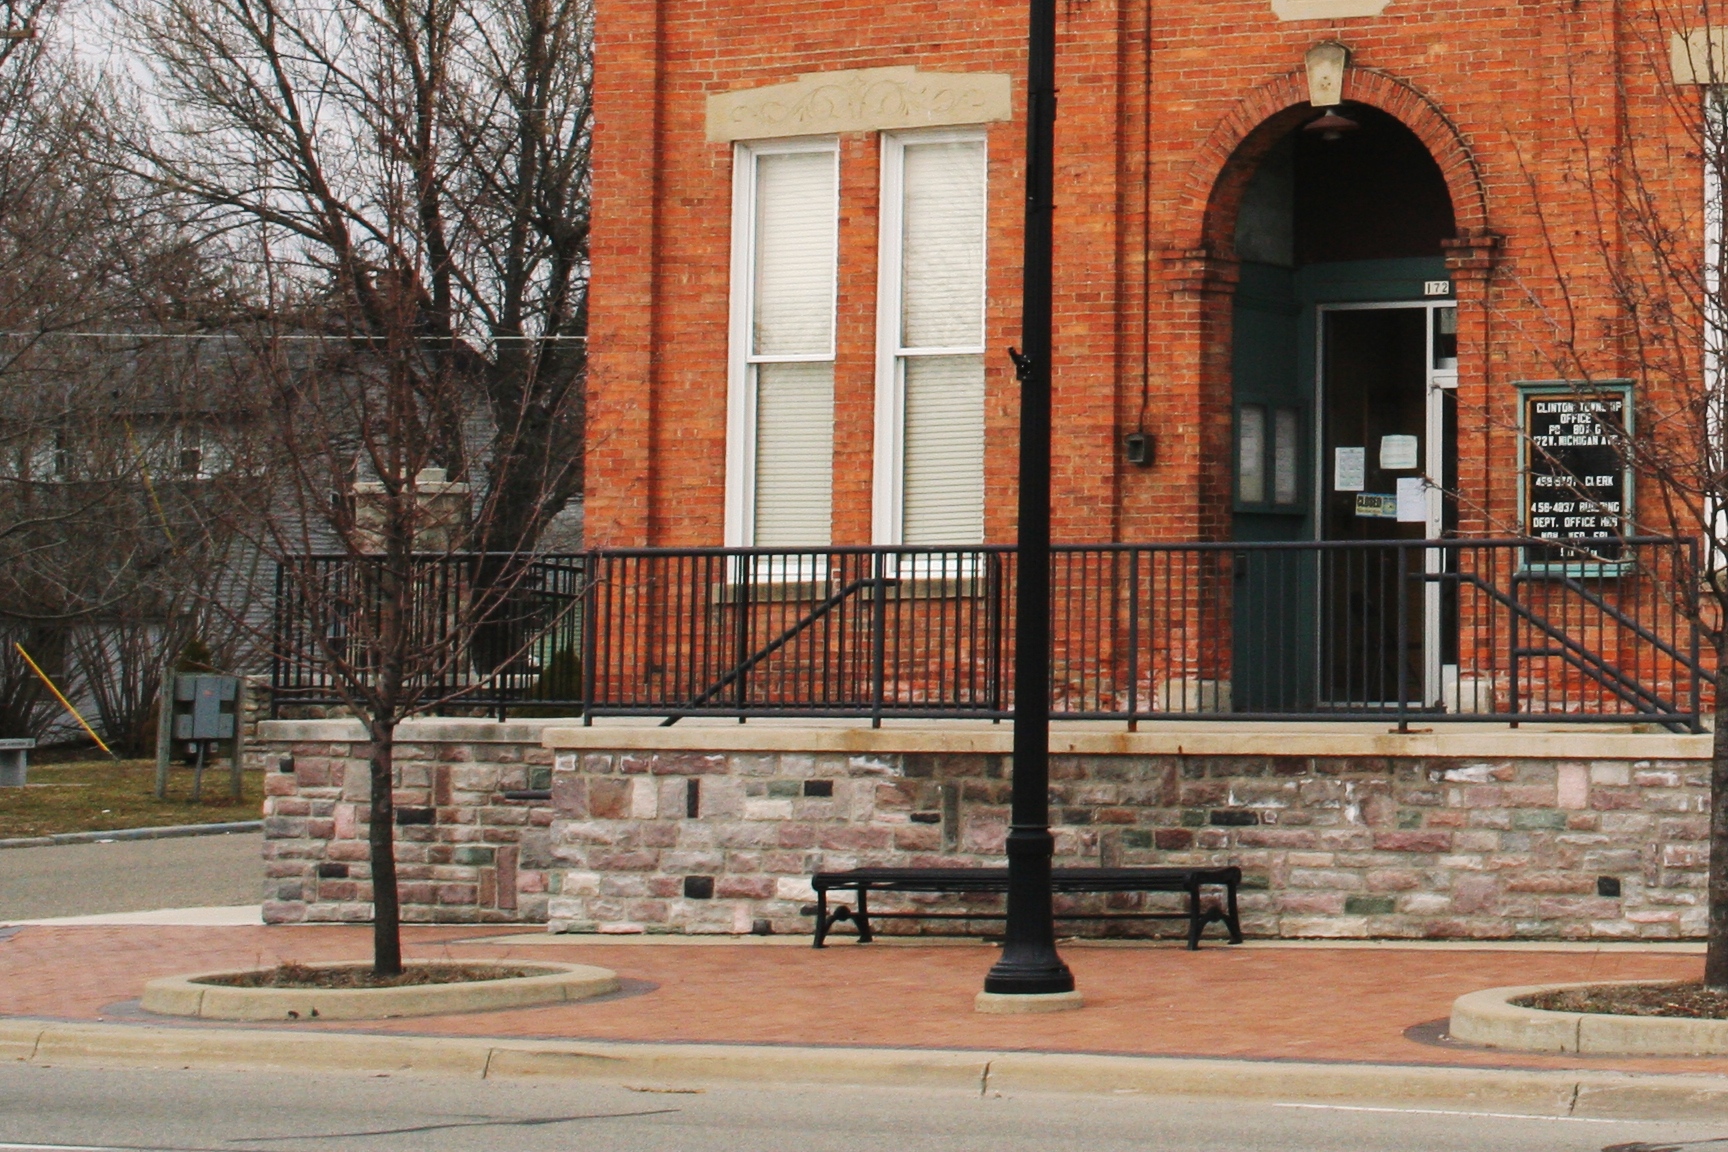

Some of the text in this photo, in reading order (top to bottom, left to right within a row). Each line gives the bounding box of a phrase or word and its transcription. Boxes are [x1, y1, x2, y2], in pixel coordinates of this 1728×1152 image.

[1427, 282, 1448, 294] 172
[1536, 401, 1622, 413] CLINTON TOWNIP
[1560, 413, 1592, 424] OFFICE
[1558, 435, 1599, 446] MICHIGAN
[1585, 475, 1614, 487] CLERK
[1533, 516, 1559, 528] DEPT.
[1564, 516, 1596, 528] OFFICE
